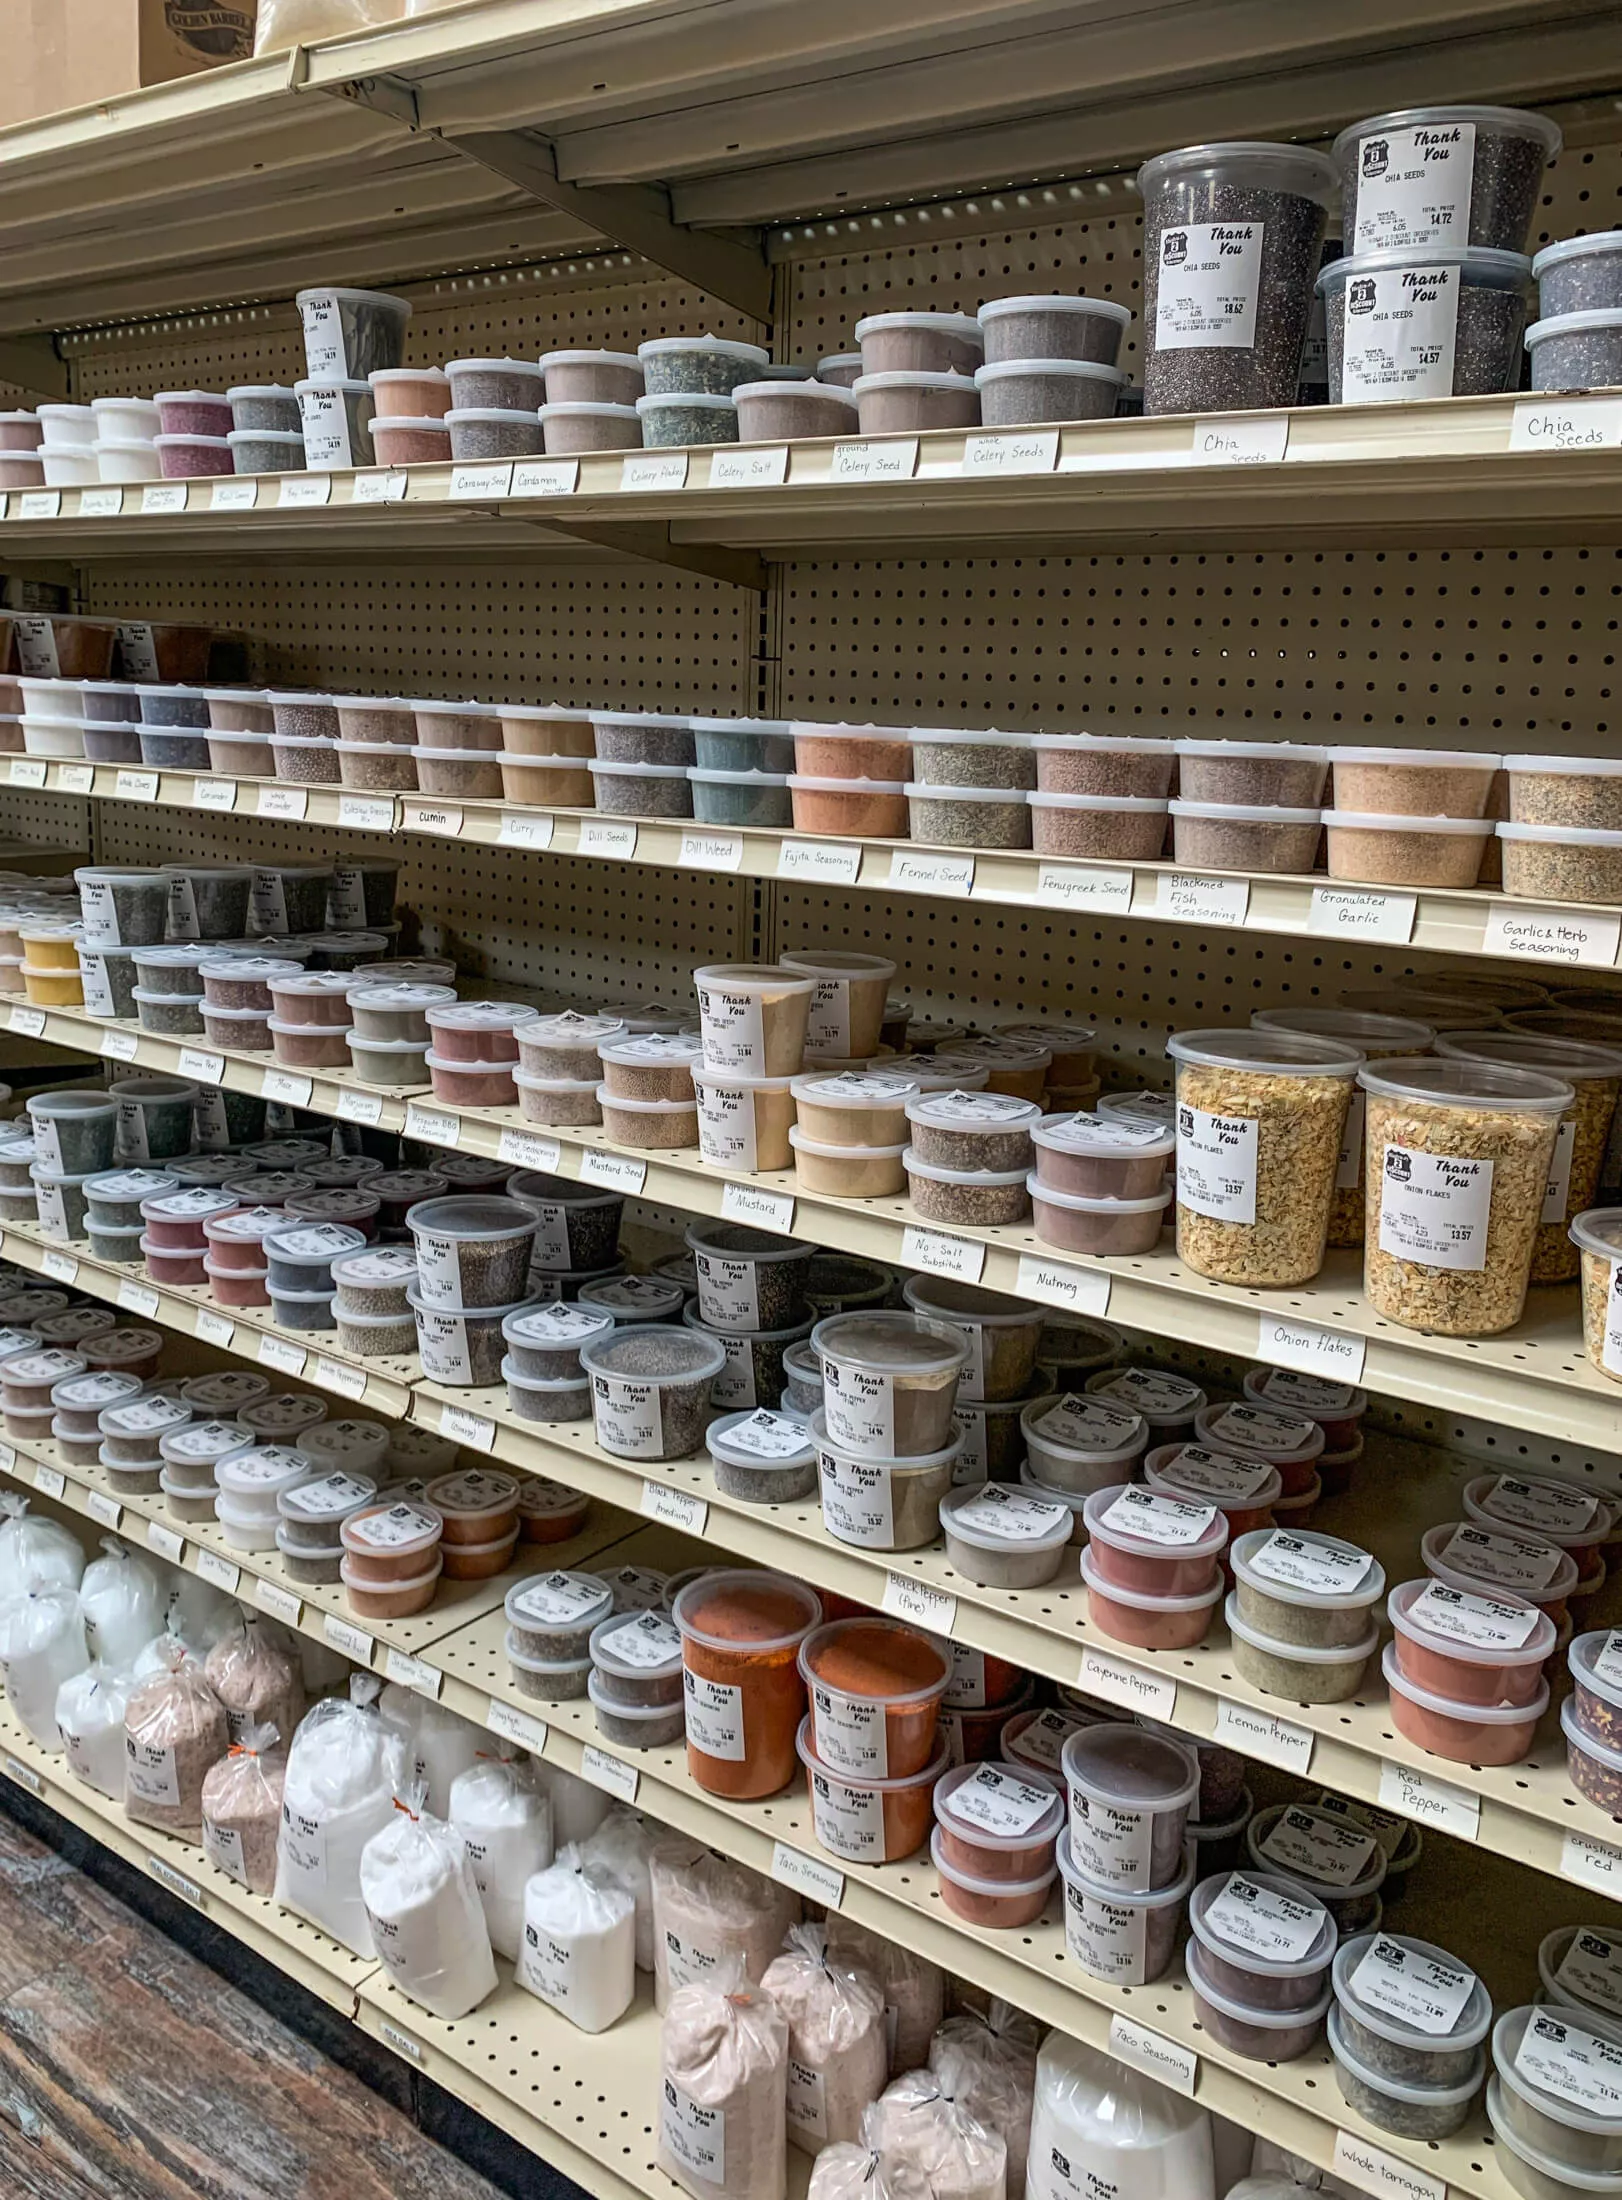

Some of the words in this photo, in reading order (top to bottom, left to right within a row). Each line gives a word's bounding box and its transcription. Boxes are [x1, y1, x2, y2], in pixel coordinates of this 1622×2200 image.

[170, 11, 209, 28] GOLDEN
[210, 11, 248, 28] BARREL
[1414, 128, 1461, 146] Thank
[1424, 147, 1450, 161] You
[1385, 174, 1400, 183] CHIA
[1404, 170, 1425, 180] SEEDS
[1431, 213, 1452, 225] $4.72
[1211, 227, 1253, 240] Thank
[1219, 242, 1243, 255] You
[1402, 270, 1448, 287] Thank
[1412, 289, 1437, 302] You
[309, 300, 332, 311] Thank
[1225, 304, 1243, 314] $8.62
[315, 311, 328, 320] You
[1373, 313, 1388, 321] CHIA
[1392, 311, 1413, 319] SEEDS
[1419, 353, 1440, 364] $4.57
[312, 390, 337, 400] Thank
[318, 401, 332, 409] You
[1527, 417, 1574, 437] Chia
[1204, 433, 1240, 451] Chia
[1555, 430, 1604, 448] Seeds
[837, 444, 869, 457] ground
[973, 449, 1005, 463] Celery
[1011, 444, 1044, 458] Seeds
[718, 463, 745, 478] Celery
[751, 461, 772, 474] Salt
[840, 459, 870, 473] Celery
[876, 459, 900, 471] Seed
[458, 477, 490, 491] Caraway
[491, 475, 506, 486] Seed
[630, 470, 657, 483] Celery
[419, 811, 446, 824] cumin
[510, 820, 535, 839] Curry
[588, 830, 602, 843] Dill
[606, 831, 629, 843] Seeds
[686, 840, 702, 855] Dill
[705, 840, 733, 857] Weed
[784, 849, 810, 866] Fajita
[815, 851, 854, 872] Seasoning
[899, 862, 937, 881] Fennel
[940, 866, 968, 882] Seed
[1042, 876, 1097, 898] Fenugreek
[1101, 882, 1129, 896] Seed
[1170, 892, 1198, 905] Fish
[1320, 890, 1386, 907] Granulated
[1338, 908, 1380, 924] Garlic
[1502, 921, 1544, 937] Garlic
[1557, 926, 1588, 943] Herb
[1509, 938, 1580, 961] Seasoning
[722, 995, 751, 1005] Thank
[817, 991, 833, 1000] You
[729, 1006, 745, 1016] You
[715, 1089, 744, 1100] Thank
[721, 1101, 738, 1110] You
[1210, 1118, 1248, 1133] Thank
[1218, 1132, 1239, 1144] You
[1204, 1144, 1224, 1155] FLAKES
[589, 1159, 620, 1174] Mustard
[625, 1165, 643, 1178] Seed
[1436, 1160, 1480, 1175] Thank
[1445, 1175, 1470, 1188] You
[1225, 1184, 1242, 1195] $3.57
[1404, 1184, 1423, 1195] ONION
[1425, 1189, 1450, 1199] FLAKES
[736, 1195, 775, 1215] Mustard
[1451, 1230, 1471, 1240] $3.57
[428, 1239, 451, 1249] Thank
[915, 1239, 928, 1251] No
[941, 1244, 962, 1257] Salt
[433, 1249, 446, 1258] You
[721, 1262, 747, 1271] Thank
[728, 1271, 743, 1279] You
[1036, 1273, 1077, 1299] Nutmeg
[433, 1317, 458, 1326] Thank
[440, 1326, 453, 1334] You
[1274, 1326, 1310, 1349] Onion
[1316, 1333, 1353, 1357] flakes
[853, 1373, 884, 1386] Thank
[623, 1385, 651, 1393] Thank
[861, 1385, 878, 1395] You
[630, 1394, 646, 1402] You
[851, 1465, 882, 1477] Thank
[858, 1477, 876, 1486] You
[649, 1483, 668, 1499] Black
[672, 1488, 697, 1506] Pepper
[1173, 1502, 1207, 1514] Thank
[1179, 1509, 1197, 1518] You
[1326, 1550, 1362, 1564] Thank
[1330, 1557, 1350, 1566] You
[889, 1572, 917, 1595] Black
[918, 1583, 950, 1605] Pepper
[898, 1593, 926, 1615] (fine)
[1486, 1602, 1527, 1617] Thank
[1492, 1610, 1514, 1620] You
[1086, 1660, 1129, 1685] Cayenne
[1129, 1675, 1161, 1696] Pepper
[707, 1684, 733, 1696] Thank
[713, 1695, 728, 1704] You
[847, 1704, 877, 1713] Thank
[853, 1713, 870, 1723] You
[1227, 1710, 1267, 1736] Lemon
[1270, 1723, 1309, 1747] Pepper
[1396, 1766, 1423, 1787] Red
[844, 1789, 874, 1800] Thank
[1018, 1785, 1049, 1801] Thank
[1022, 1793, 1037, 1804] You
[851, 1799, 868, 1808] You
[1402, 1785, 1449, 1816] Pepper
[1107, 1808, 1141, 1823] Thank
[1114, 1821, 1133, 1832] You
[1571, 1838, 1622, 1860] crushed
[1586, 1855, 1612, 1871] red
[779, 1854, 798, 1873] Taco
[801, 1864, 839, 1898] Seasoning
[1101, 1903, 1135, 1917] Thank
[1279, 1899, 1313, 1917] Thank
[1282, 1909, 1302, 1920] You
[1109, 1916, 1128, 1927] You
[548, 1942, 570, 1959] Thank
[552, 1952, 566, 1964] You
[1427, 1963, 1465, 1983] Thank
[1432, 1974, 1453, 1987] You
[1116, 2027, 1137, 2047] Taco
[1143, 2041, 1189, 2079] Seasoning
[1592, 2039, 1622, 2058] Than
[1600, 2051, 1622, 2065] You
[792, 2062, 817, 2081] Thank
[798, 2073, 812, 2086] You
[689, 2102, 716, 2120] Thank
[694, 2115, 710, 2127] You
[1341, 2148, 1375, 2174] whole
[1380, 2165, 1435, 2200] tarragon
[1088, 2173, 1118, 2193] Thank
[1095, 2185, 1111, 2199] You
